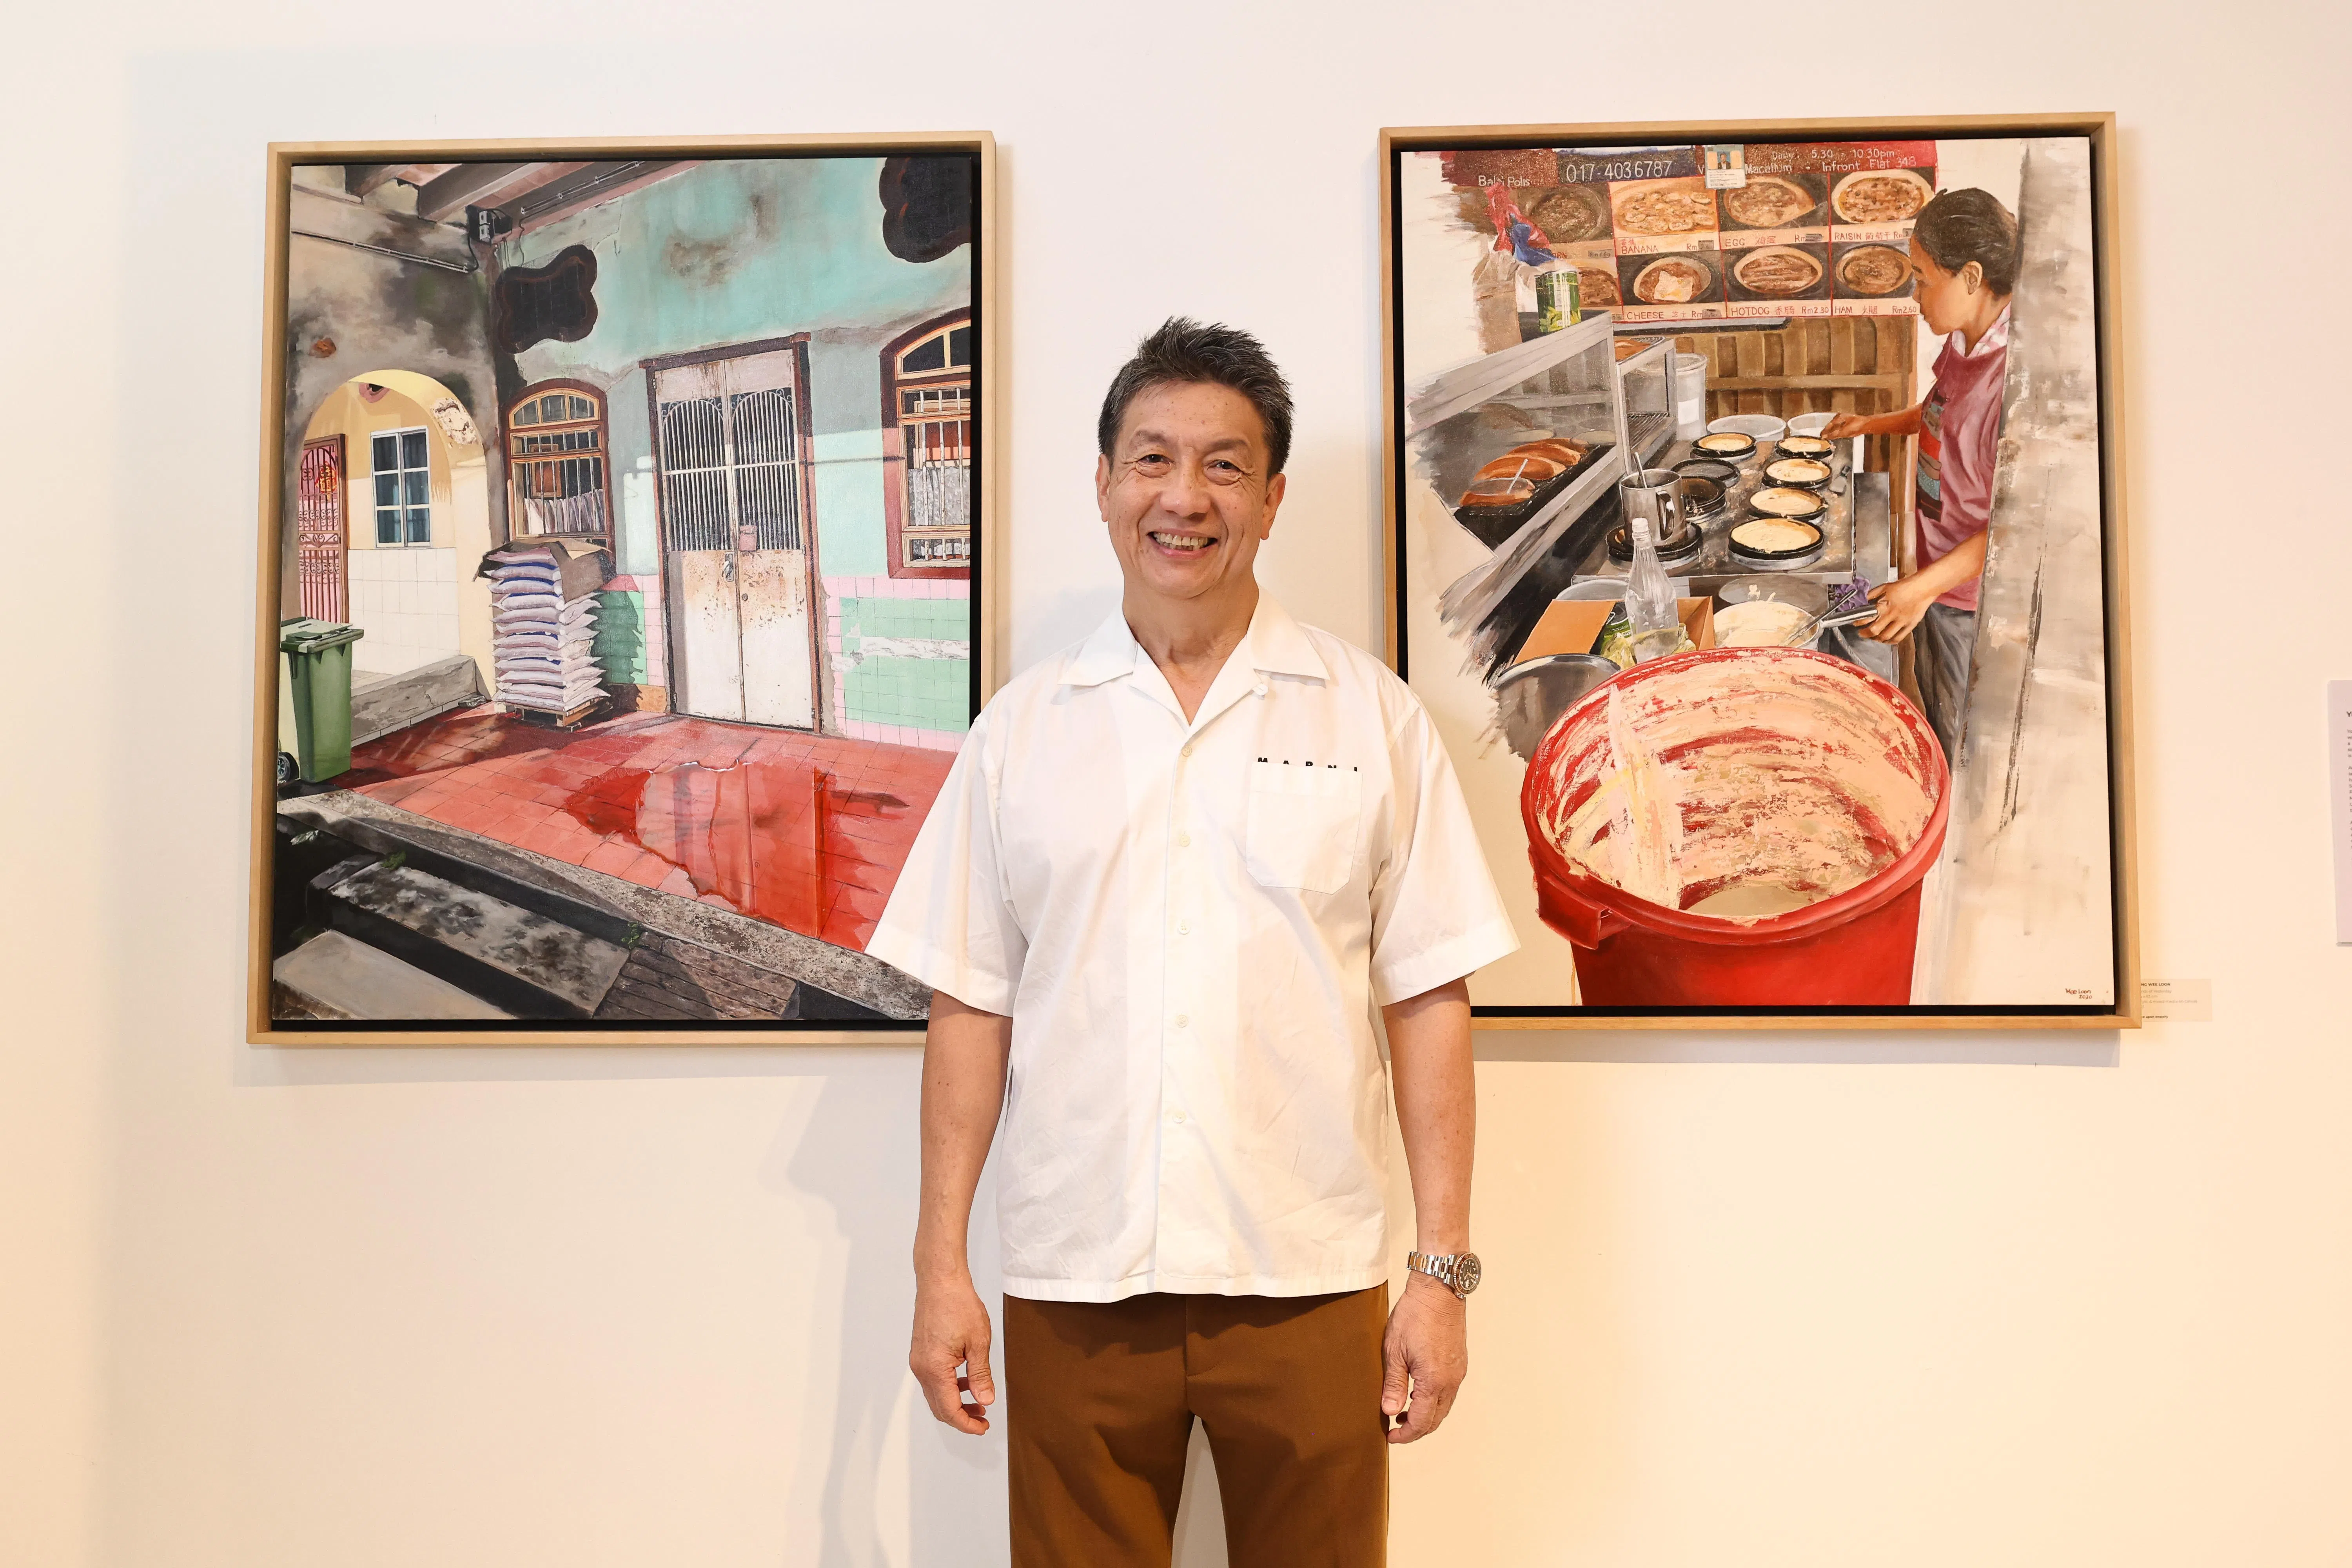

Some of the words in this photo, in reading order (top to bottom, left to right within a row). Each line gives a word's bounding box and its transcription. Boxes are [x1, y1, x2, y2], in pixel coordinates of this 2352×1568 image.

[1822, 160, 1861, 172] Infront
[1869, 159, 1890, 169] Flat
[1835, 232, 1862, 240] RAISIN
[1725, 238, 1745, 247] EGG
[1621, 245, 1659, 254] BANANA
[1626, 311, 1664, 320] CHEESE
[1731, 307, 1769, 316] HOTDOG
